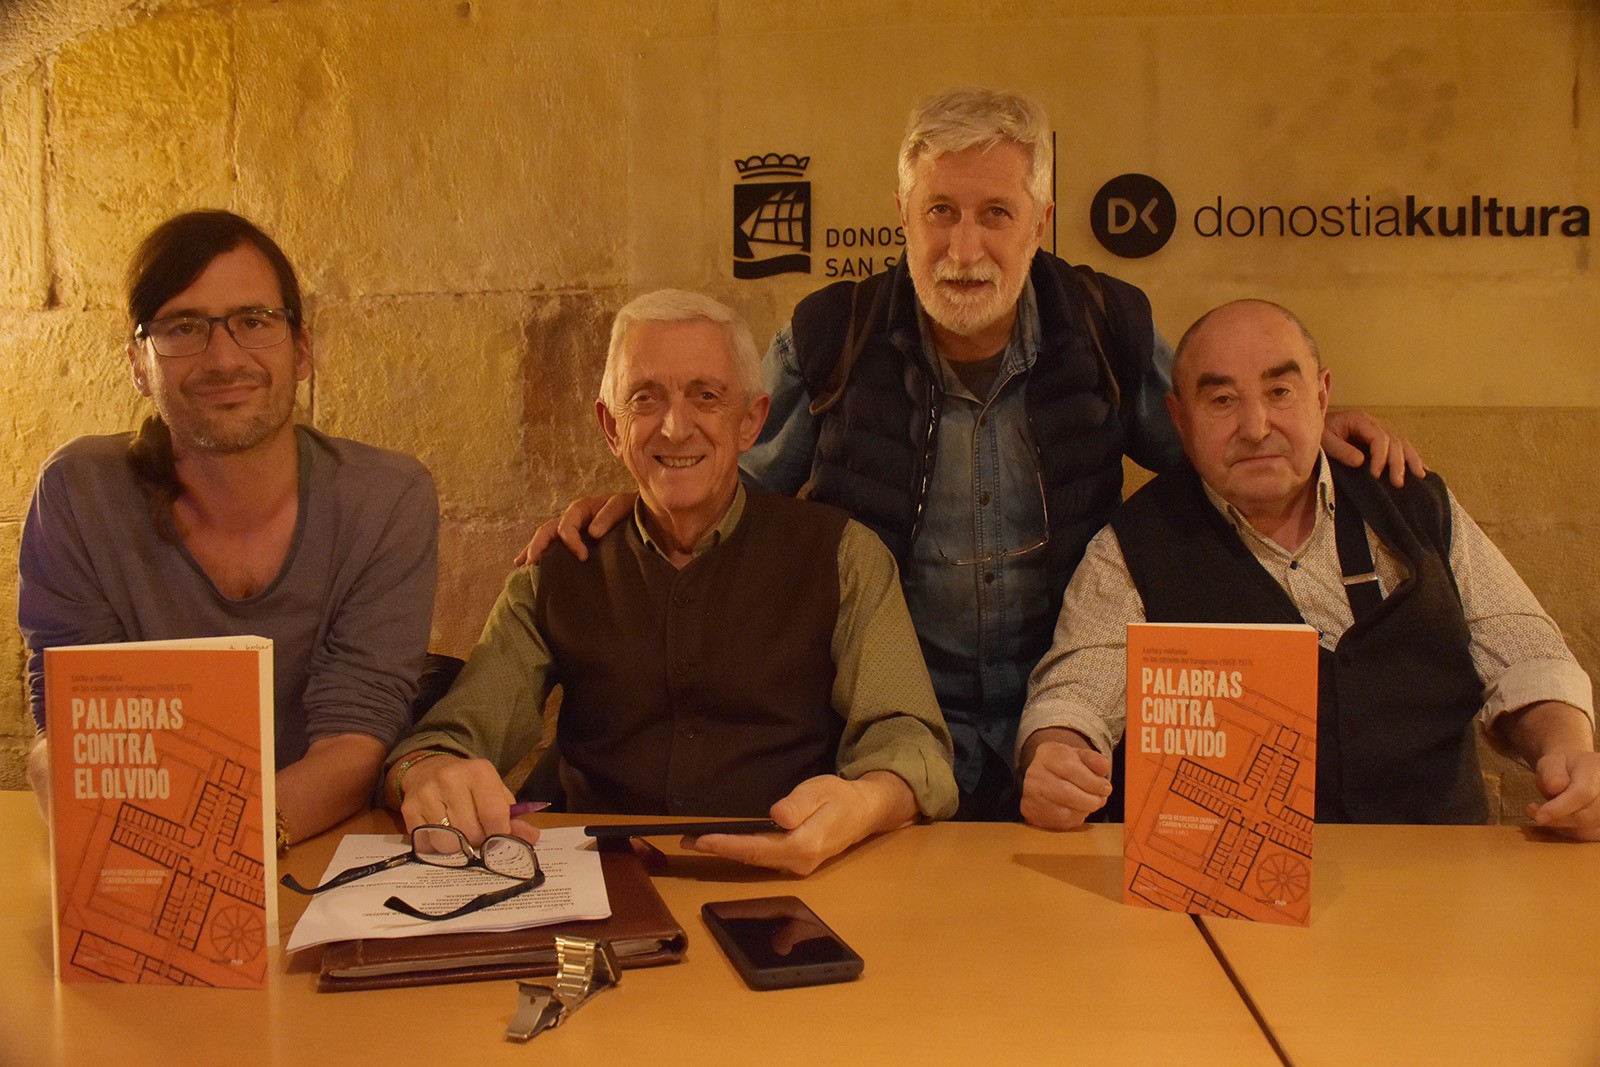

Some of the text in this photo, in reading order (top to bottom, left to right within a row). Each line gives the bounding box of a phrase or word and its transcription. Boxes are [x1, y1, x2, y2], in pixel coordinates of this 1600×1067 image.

[1193, 195, 1590, 237] donostiakultura
[825, 257, 873, 278] SAN
[1141, 667, 1243, 699] PALABRAS
[71, 697, 184, 730] PALABRAS
[1141, 696, 1216, 728] CONTRA
[73, 732, 158, 765] CONTRA
[1141, 726, 1227, 758] EL OLVIDO
[74, 767, 171, 800] EL OLVIDO
